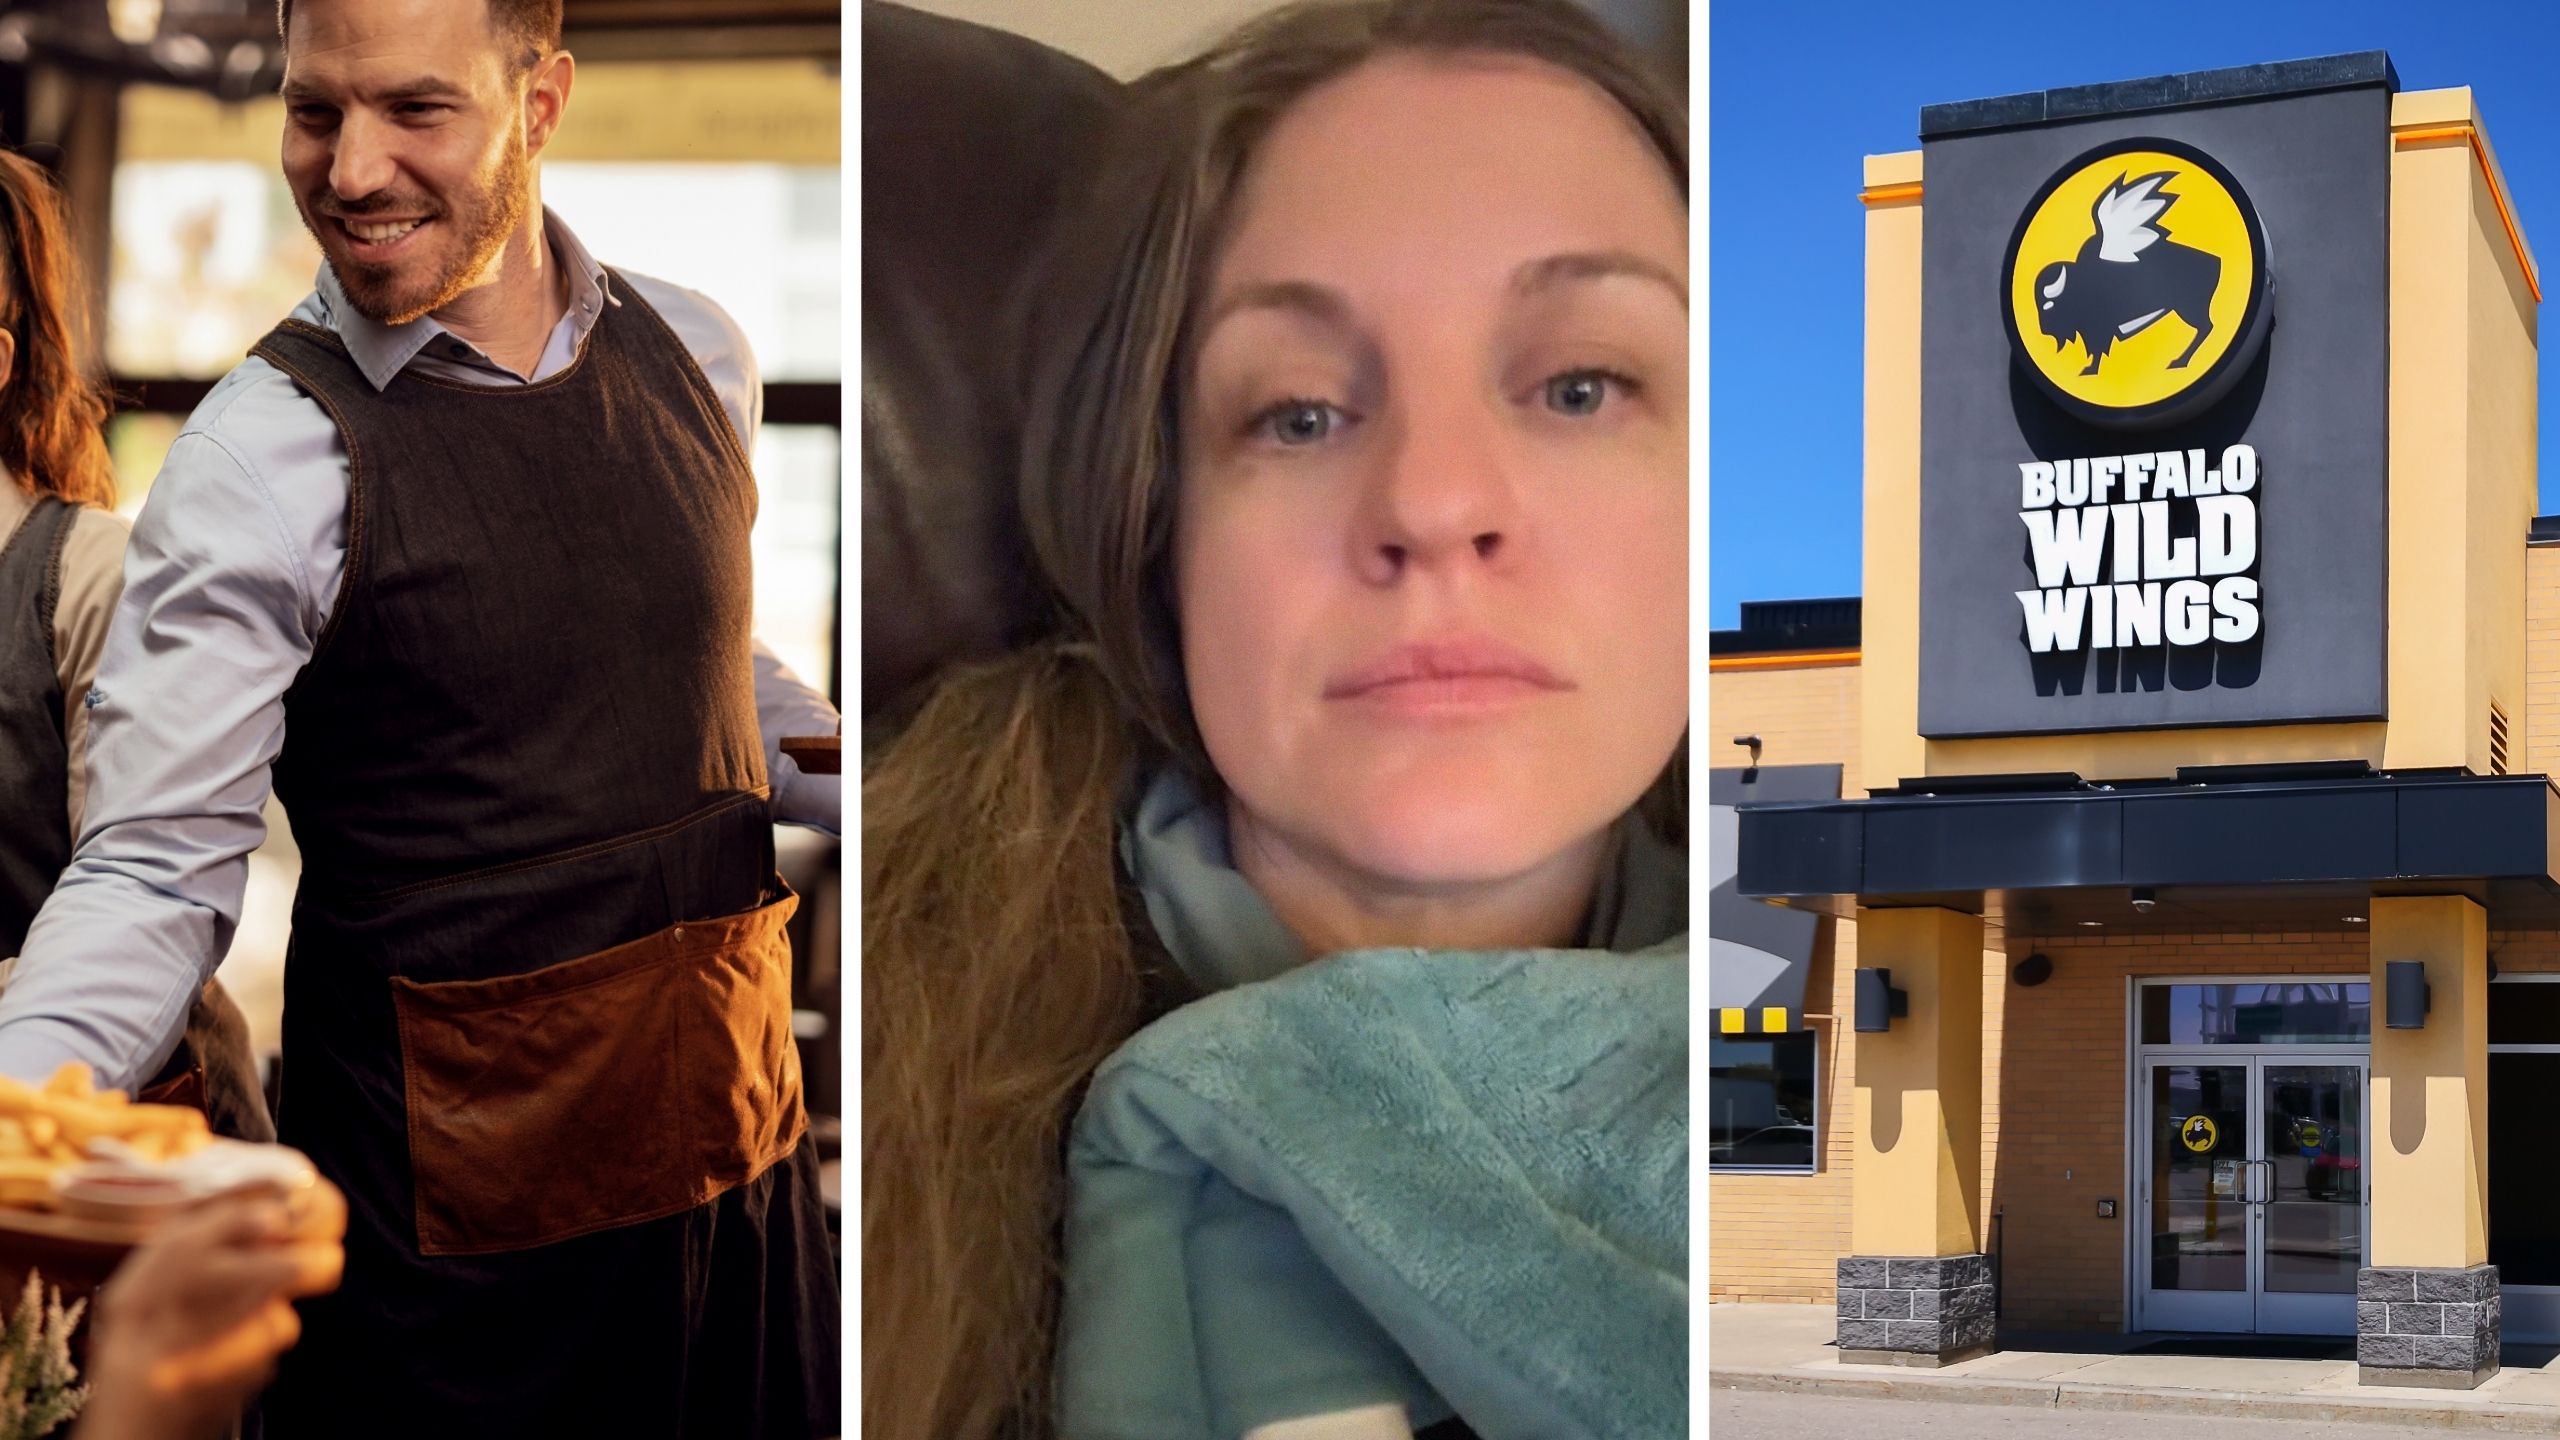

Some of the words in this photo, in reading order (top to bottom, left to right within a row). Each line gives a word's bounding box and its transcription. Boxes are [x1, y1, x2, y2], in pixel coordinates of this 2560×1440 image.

[2018, 444, 2257, 509] BUFFALO
[2018, 494, 2257, 588] WILD
[2014, 576, 2259, 653] WINGS
